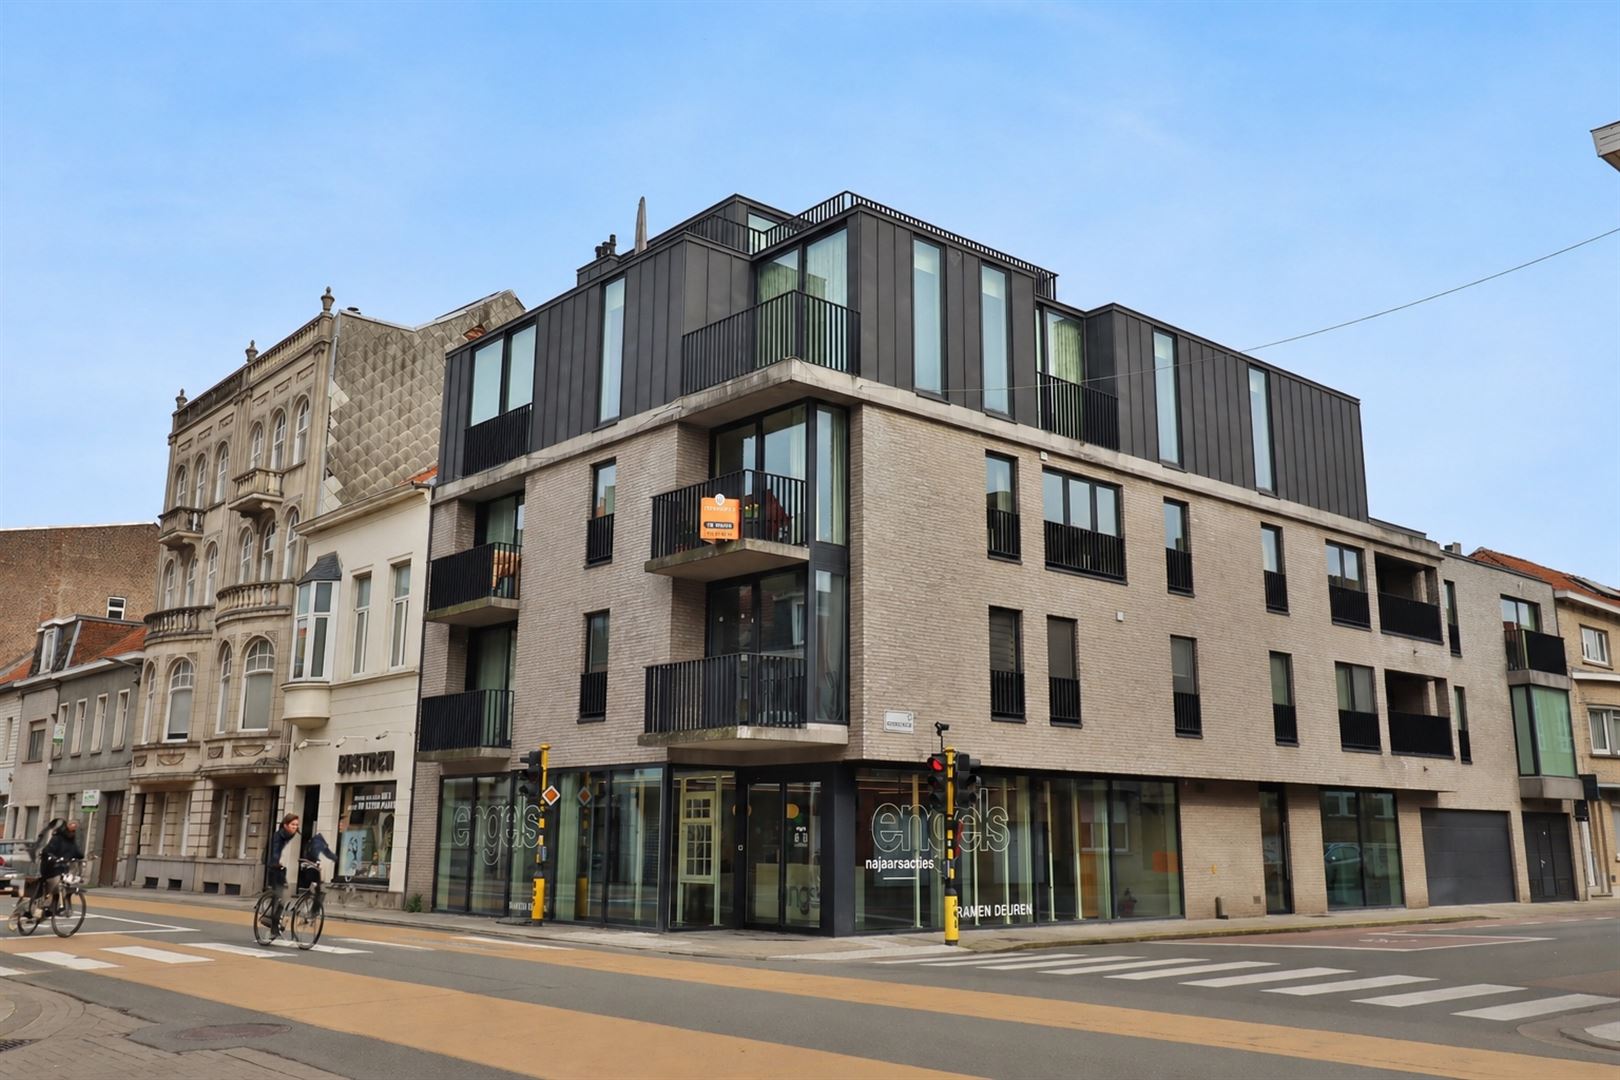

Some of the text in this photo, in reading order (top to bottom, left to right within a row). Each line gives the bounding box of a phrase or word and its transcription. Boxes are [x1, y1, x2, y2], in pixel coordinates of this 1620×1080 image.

[865, 856, 935, 873] najaarsacties
[956, 904, 992, 919] RAMEN
[994, 903, 1033, 917] DEUREN
